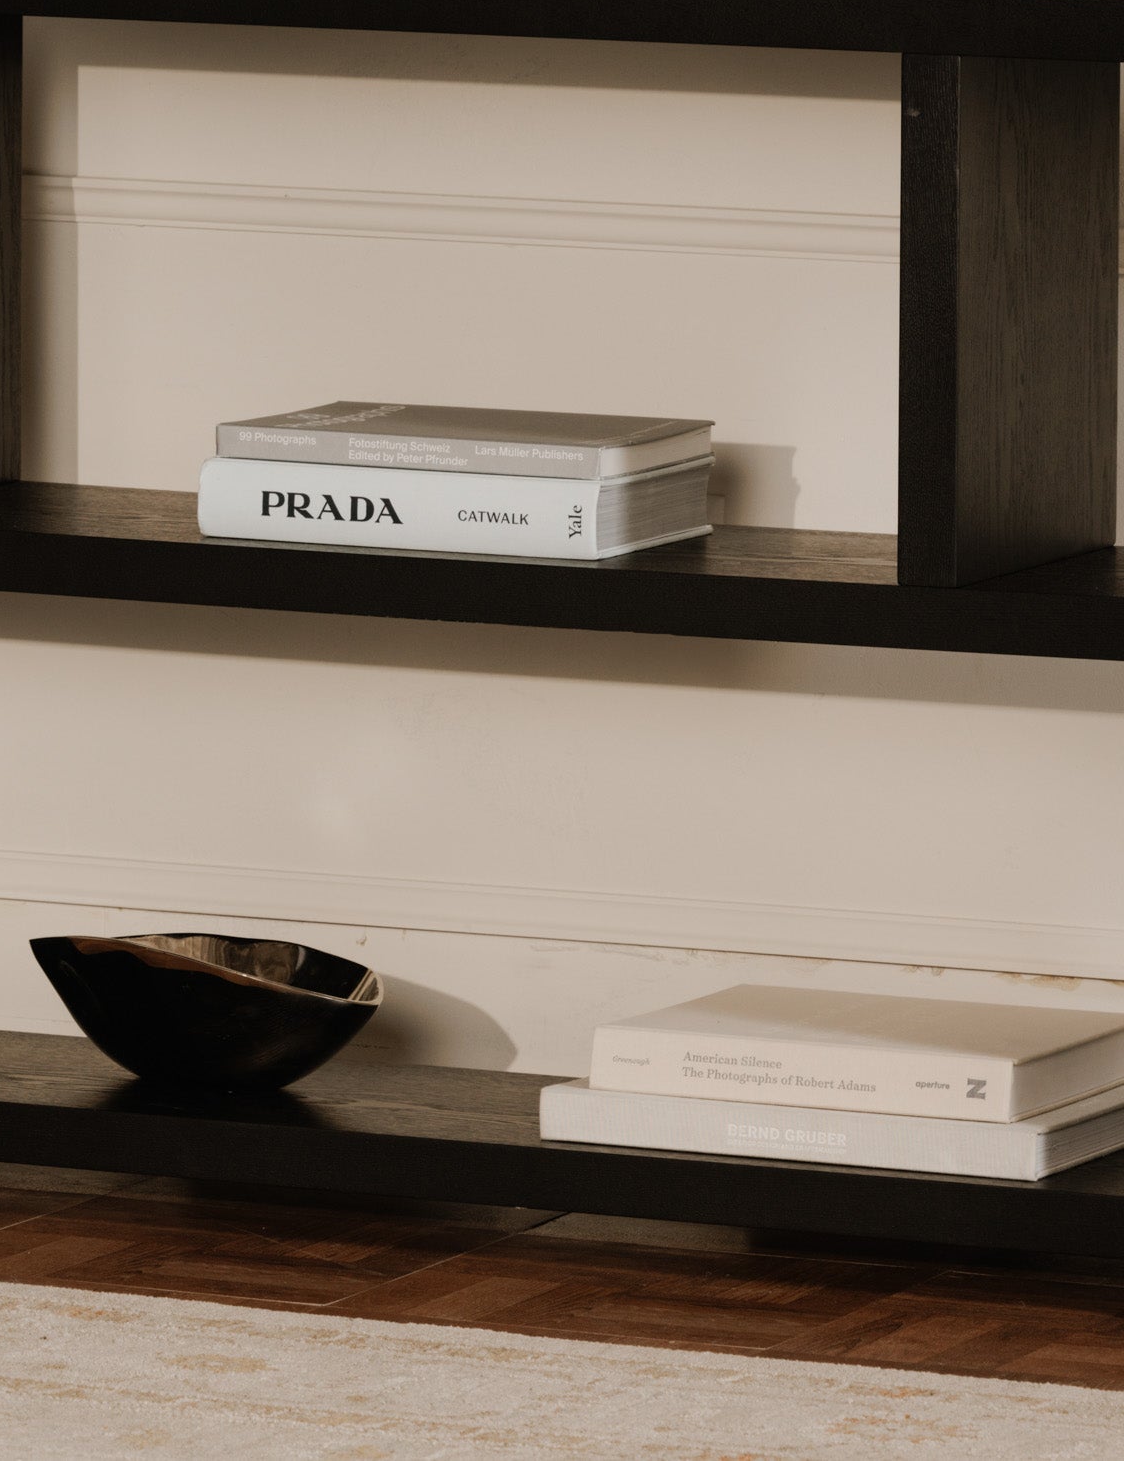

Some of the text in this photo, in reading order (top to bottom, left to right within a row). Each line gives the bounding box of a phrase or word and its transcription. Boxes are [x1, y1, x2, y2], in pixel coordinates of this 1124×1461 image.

[238, 430, 317, 446] 99 Photographs
[348, 437, 451, 454] Fotostiftung Schweiz
[348, 450, 469, 467] Edited by Peter Pfrunder
[474, 445, 497, 456] Lars
[532, 448, 585, 461] Publishers
[261, 490, 529, 526] PRADA CATWALK
[567, 504, 583, 539] Yale
[683, 1051, 783, 1069] American Silence
[682, 1066, 877, 1093] The Photographs of Robert Adams
[915, 1080, 951, 1091] aperture
[727, 1123, 780, 1141] BERND
[784, 1128, 847, 1147] GRUBER
